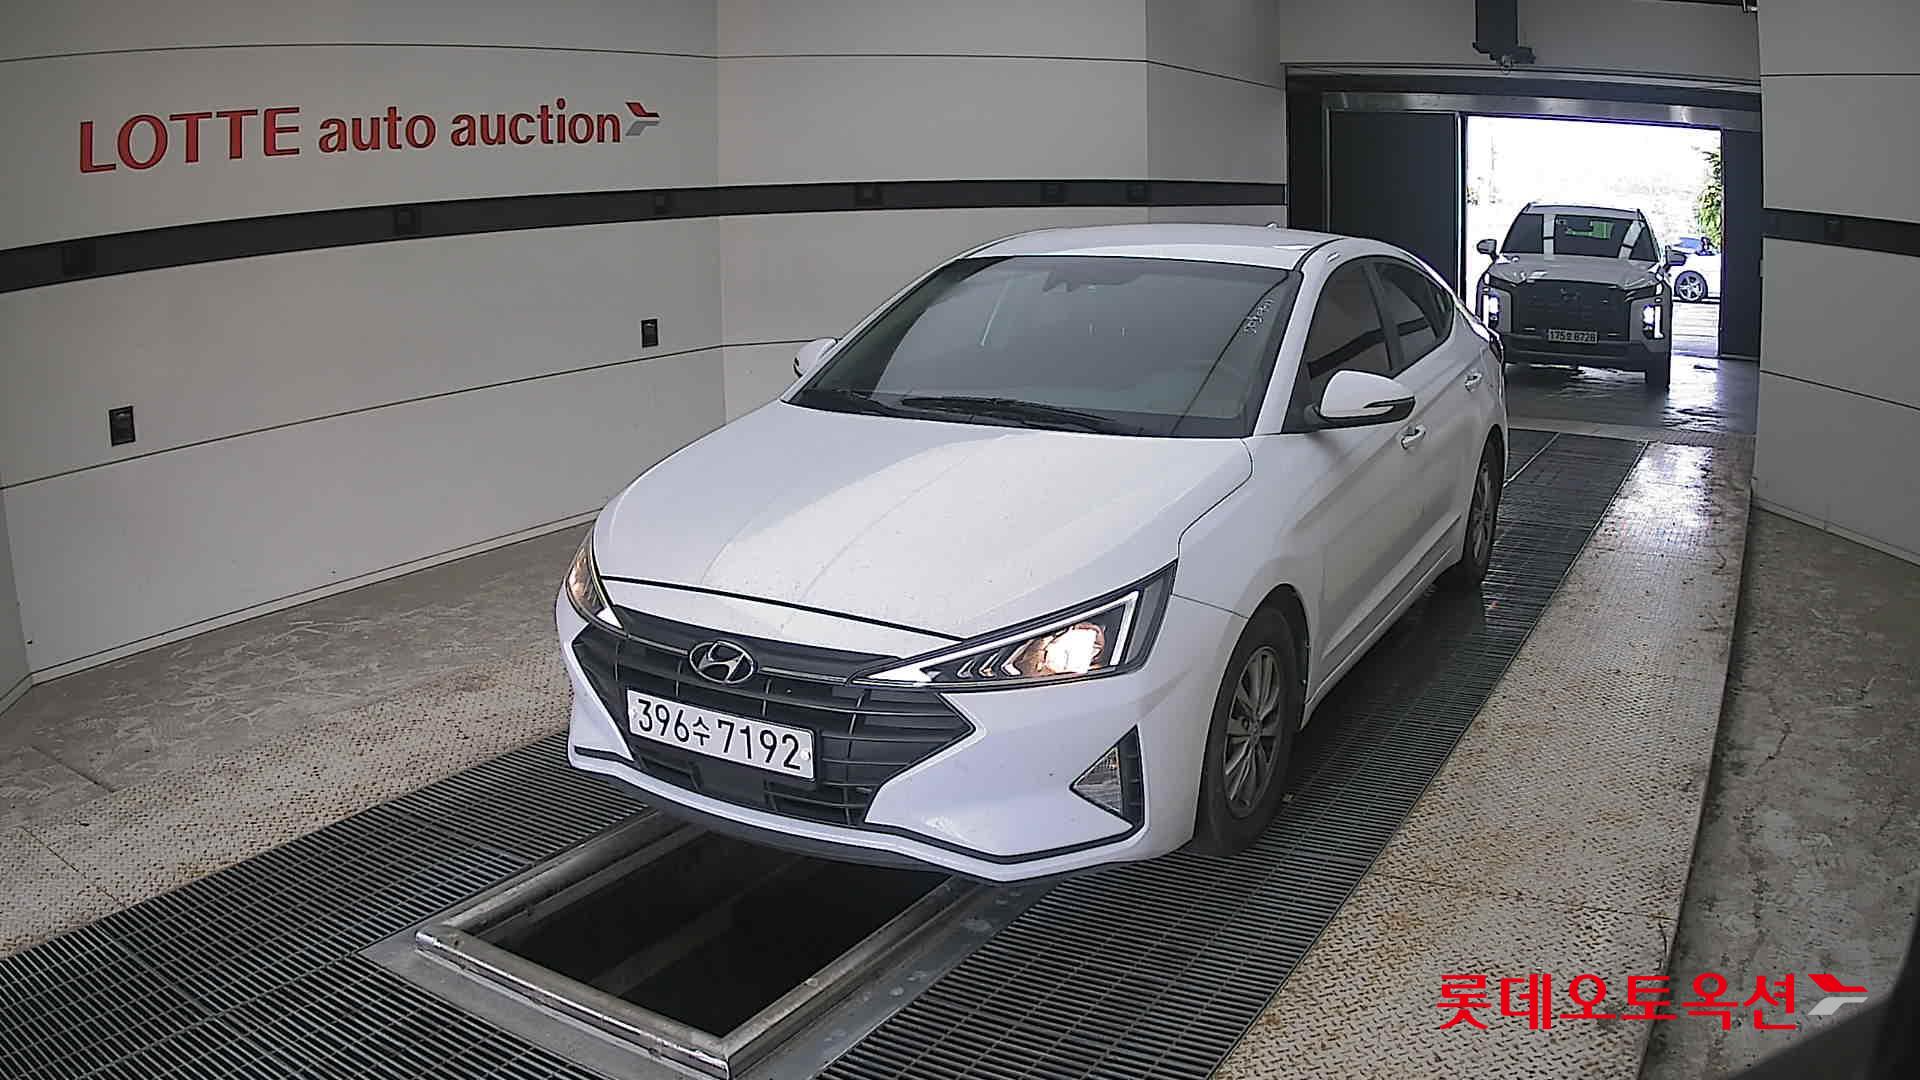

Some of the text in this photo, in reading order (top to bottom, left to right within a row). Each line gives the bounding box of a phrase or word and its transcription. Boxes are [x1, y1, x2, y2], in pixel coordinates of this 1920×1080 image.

[79, 98, 621, 174] LOTTE auto auction
